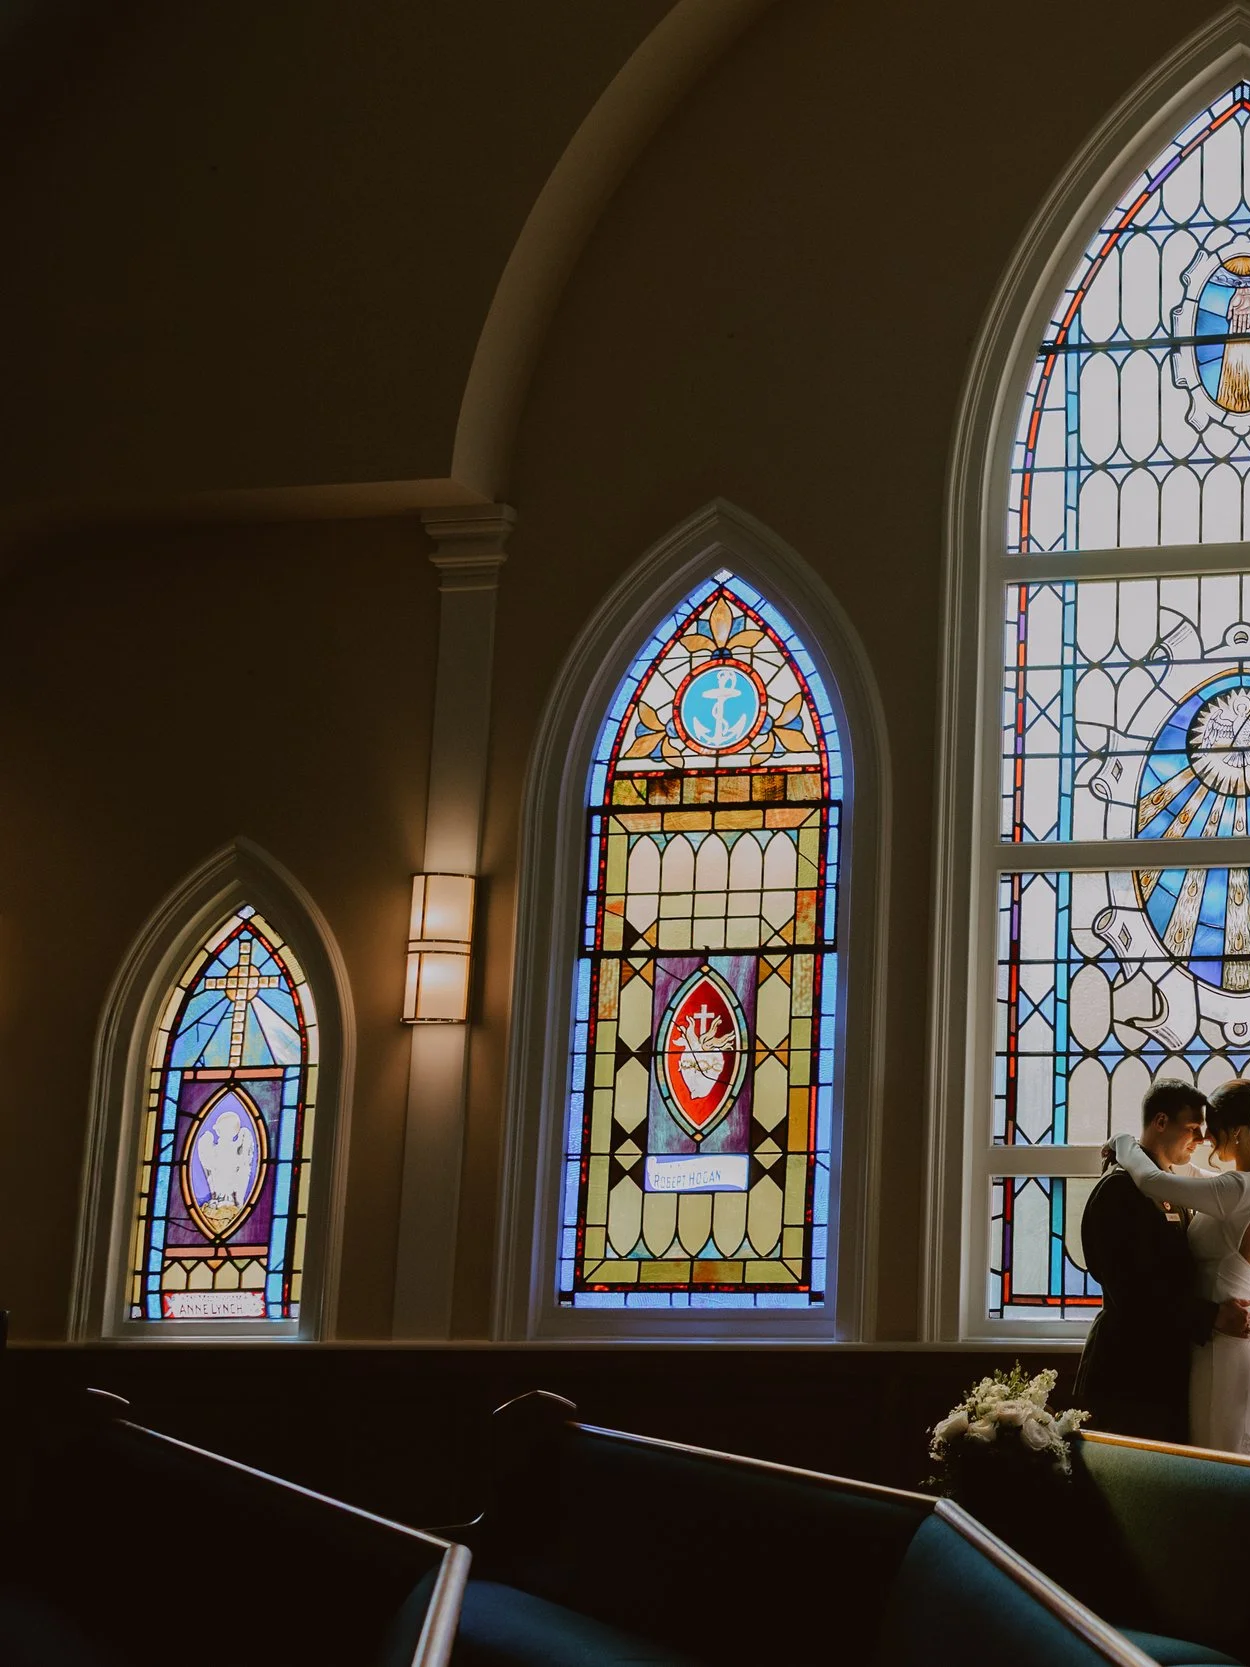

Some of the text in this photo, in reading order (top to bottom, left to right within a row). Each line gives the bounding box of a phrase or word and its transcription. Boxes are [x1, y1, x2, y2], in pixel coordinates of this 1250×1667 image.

[653, 1169, 722, 1189] ROBERT HOGAN
[179, 1302, 244, 1314] ANNE LYNCH
